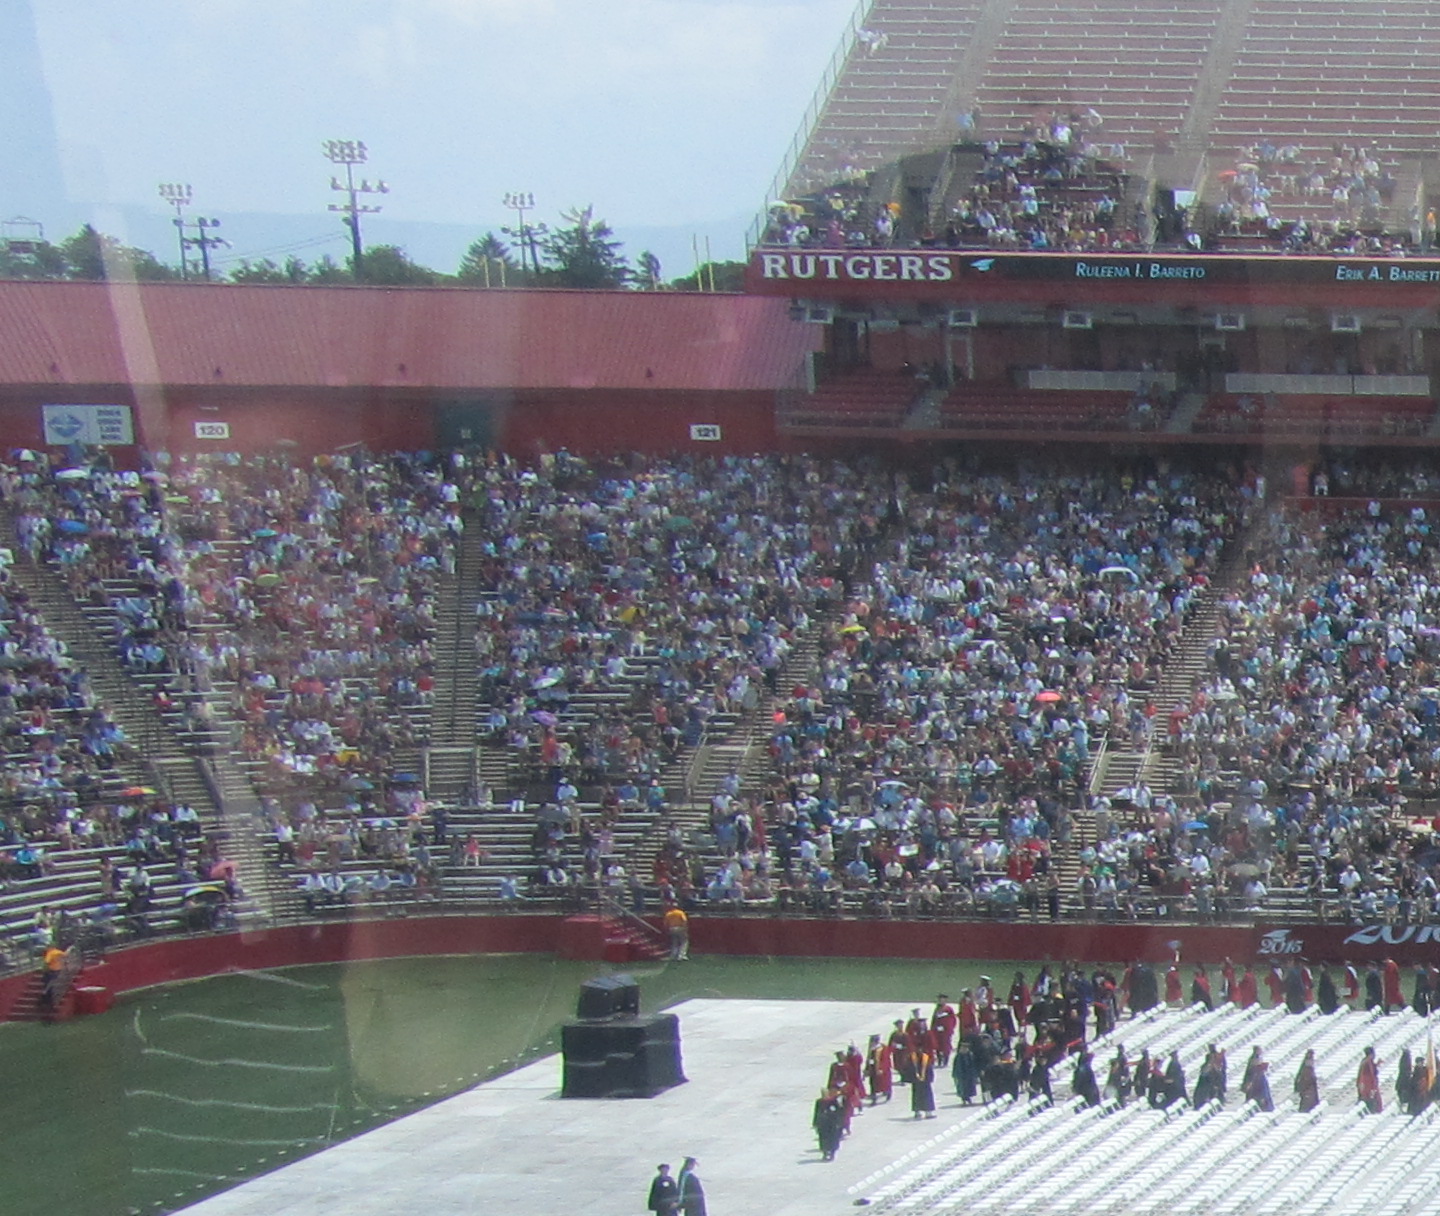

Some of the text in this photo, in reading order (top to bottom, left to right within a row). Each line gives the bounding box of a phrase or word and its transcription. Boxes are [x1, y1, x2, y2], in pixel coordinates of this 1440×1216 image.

[762, 255, 953, 281] RUTGERS
[1149, 263, 1206, 279] BARRETO
[1335, 266, 1365, 280] ERIK
[1368, 266, 1384, 281] A.
[199, 425, 225, 436] 120
[696, 426, 717, 437] 121
[1256, 937, 1303, 954] 2015
